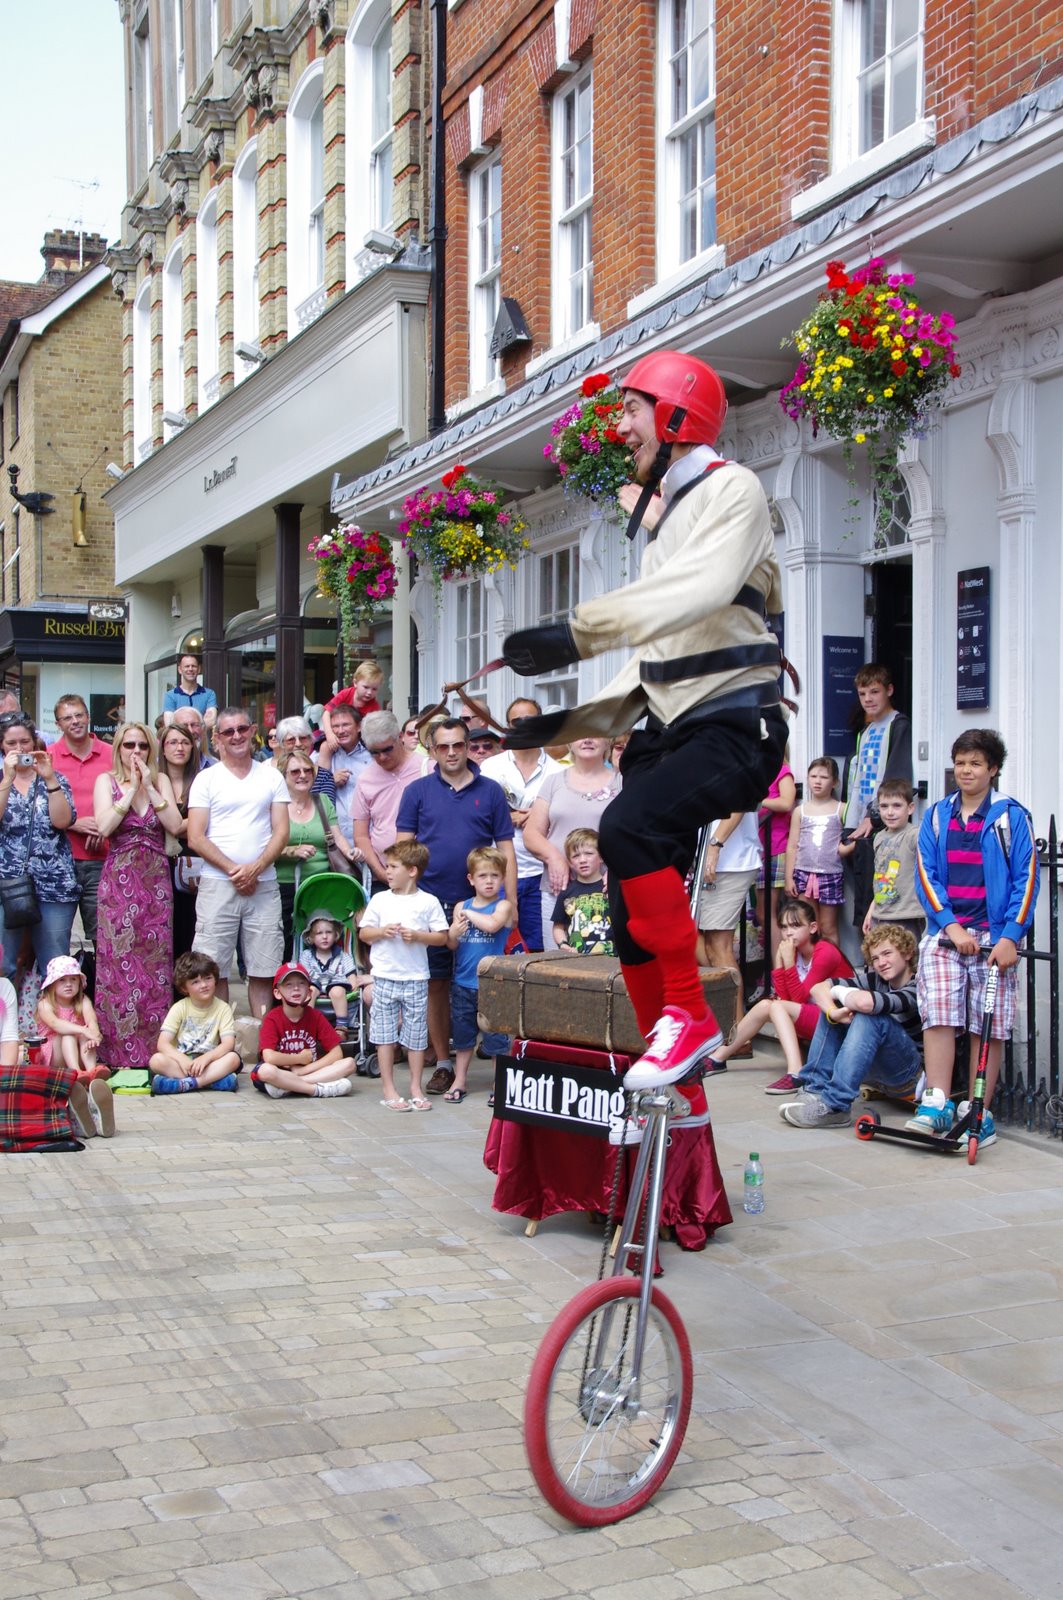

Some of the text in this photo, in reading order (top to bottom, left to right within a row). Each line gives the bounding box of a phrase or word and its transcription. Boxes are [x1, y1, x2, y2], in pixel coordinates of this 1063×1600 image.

[44, 618, 97, 636] Russell
[505, 1067, 625, 1130] Matt Pang
